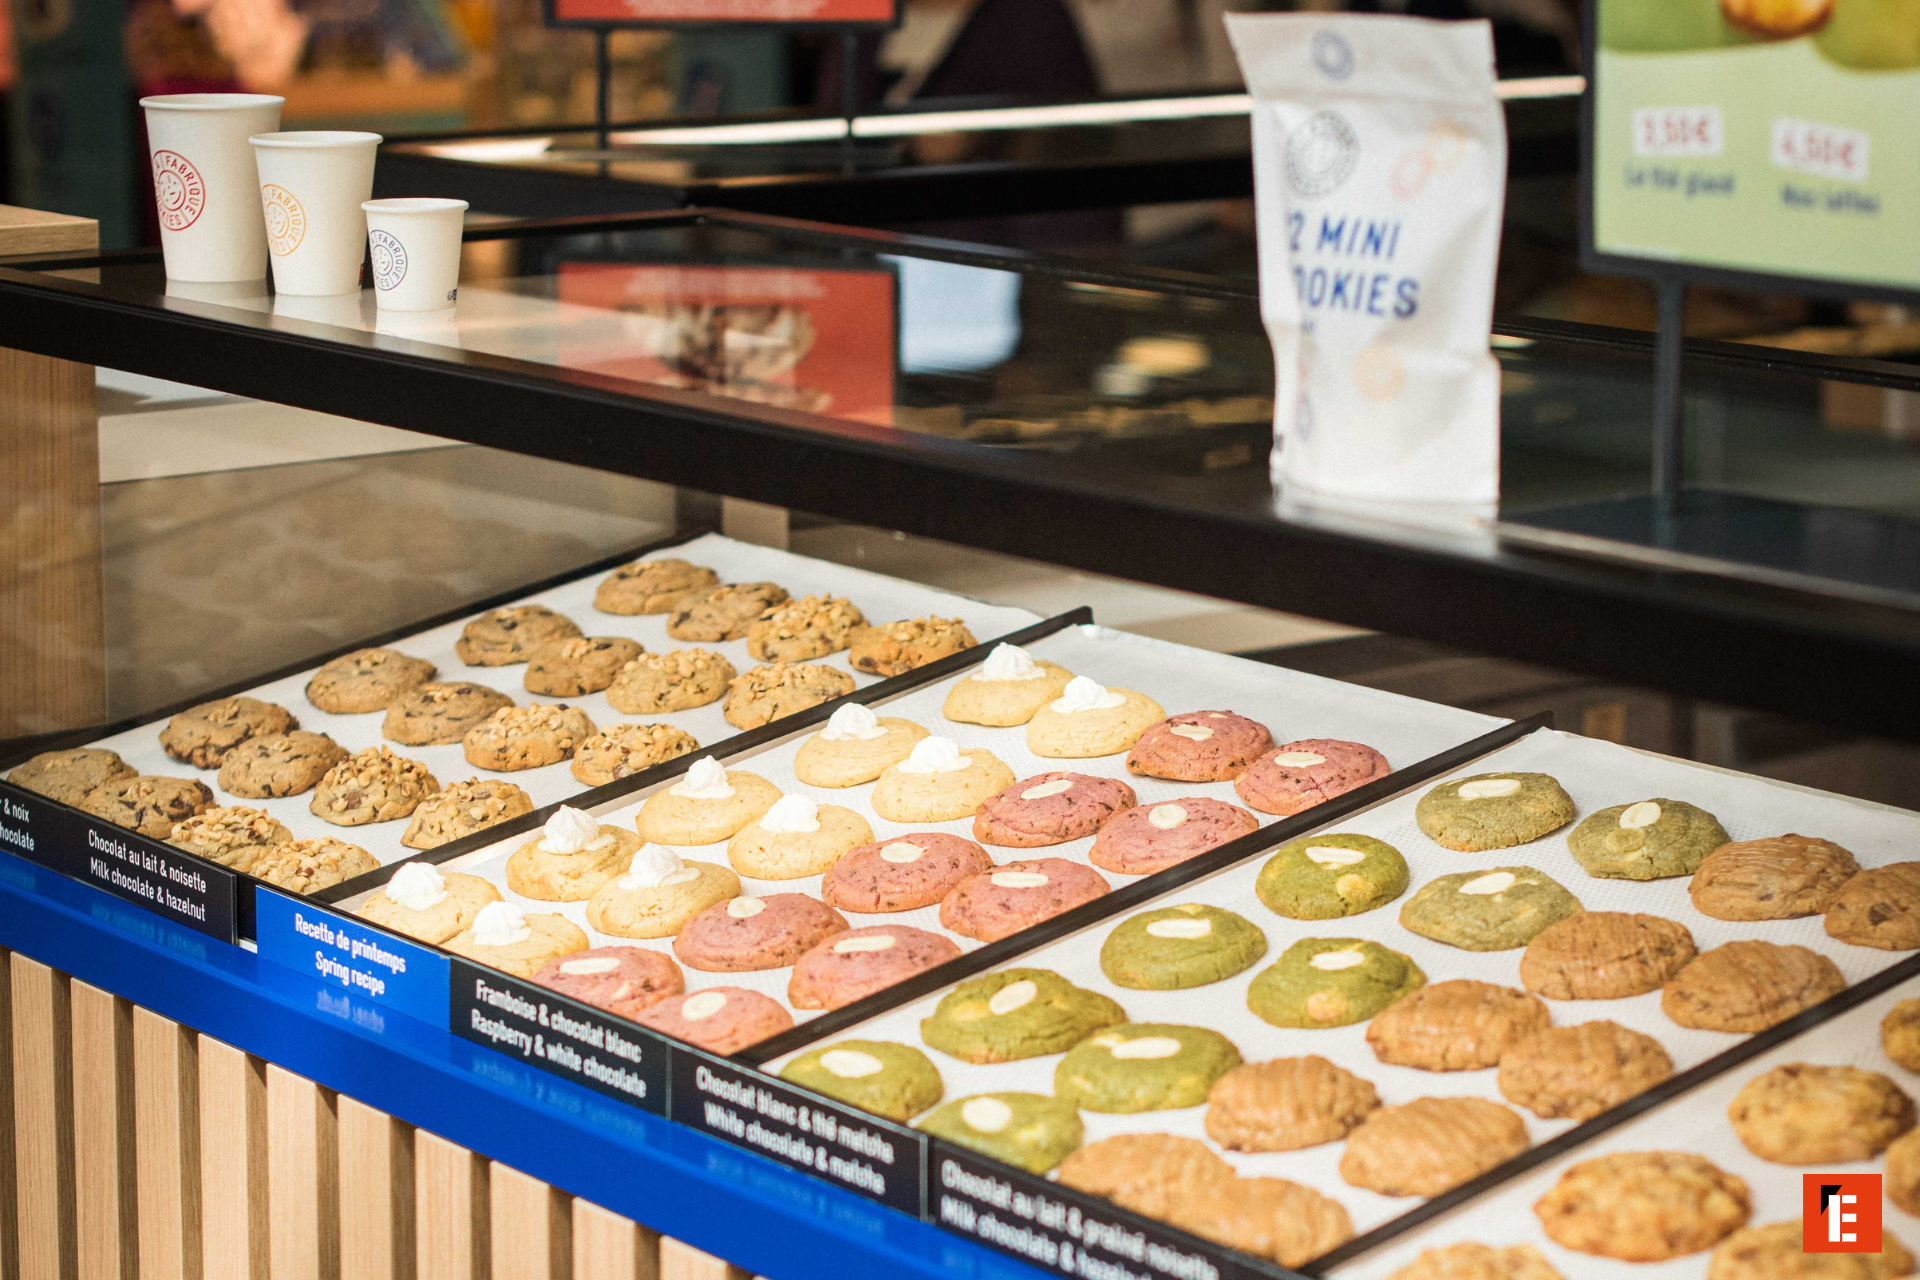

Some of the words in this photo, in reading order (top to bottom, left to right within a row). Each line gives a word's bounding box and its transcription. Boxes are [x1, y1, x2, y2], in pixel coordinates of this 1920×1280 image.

[165, 155, 200, 216] FABRIQUE
[272, 189, 302, 244] FABRIQUE
[1286, 210, 1305, 252] 2
[1316, 214, 1402, 260] MINI
[378, 233, 405, 280] FABRIQUE
[0, 821, 35, 851] hocolate
[4, 797, 11, 816] &
[12, 803, 30, 823] noix
[88, 829, 127, 861] Chocolat
[128, 850, 140, 866] au
[142, 851, 158, 874] lait
[159, 859, 168, 878] &
[169, 866, 207, 894] noisette
[90, 857, 110, 881] Milk
[111, 867, 155, 900] chocolate
[156, 886, 165, 904] &
[166, 888, 206, 922] hazelnut
[295, 912, 335, 946] Recette
[336, 929, 350, 951] de
[351, 938, 407, 975] printemps
[315, 950, 350, 987] Spring
[351, 970, 385, 997] recipe
[475, 978, 537, 1022] Framboise
[538, 1003, 550, 1027] &
[551, 1010, 604, 1049] chocolat
[605, 1028, 643, 1064] blanc
[471, 1008, 533, 1057] Raspberry
[534, 1033, 546, 1058] &
[546, 1042, 582, 1072] white
[583, 1055, 647, 1099] chocolate
[695, 1065, 756, 1111] Chocolat
[756, 1088, 798, 1126] blanc
[797, 1106, 812, 1132] &
[812, 1109, 838, 1142] thé
[837, 1125, 895, 1165] matcha
[703, 1100, 745, 1138] White
[746, 1119, 815, 1166] chocolate
[815, 1146, 829, 1173] &
[829, 1156, 887, 1196] matcha
[941, 1159, 1012, 1211] Chocolat
